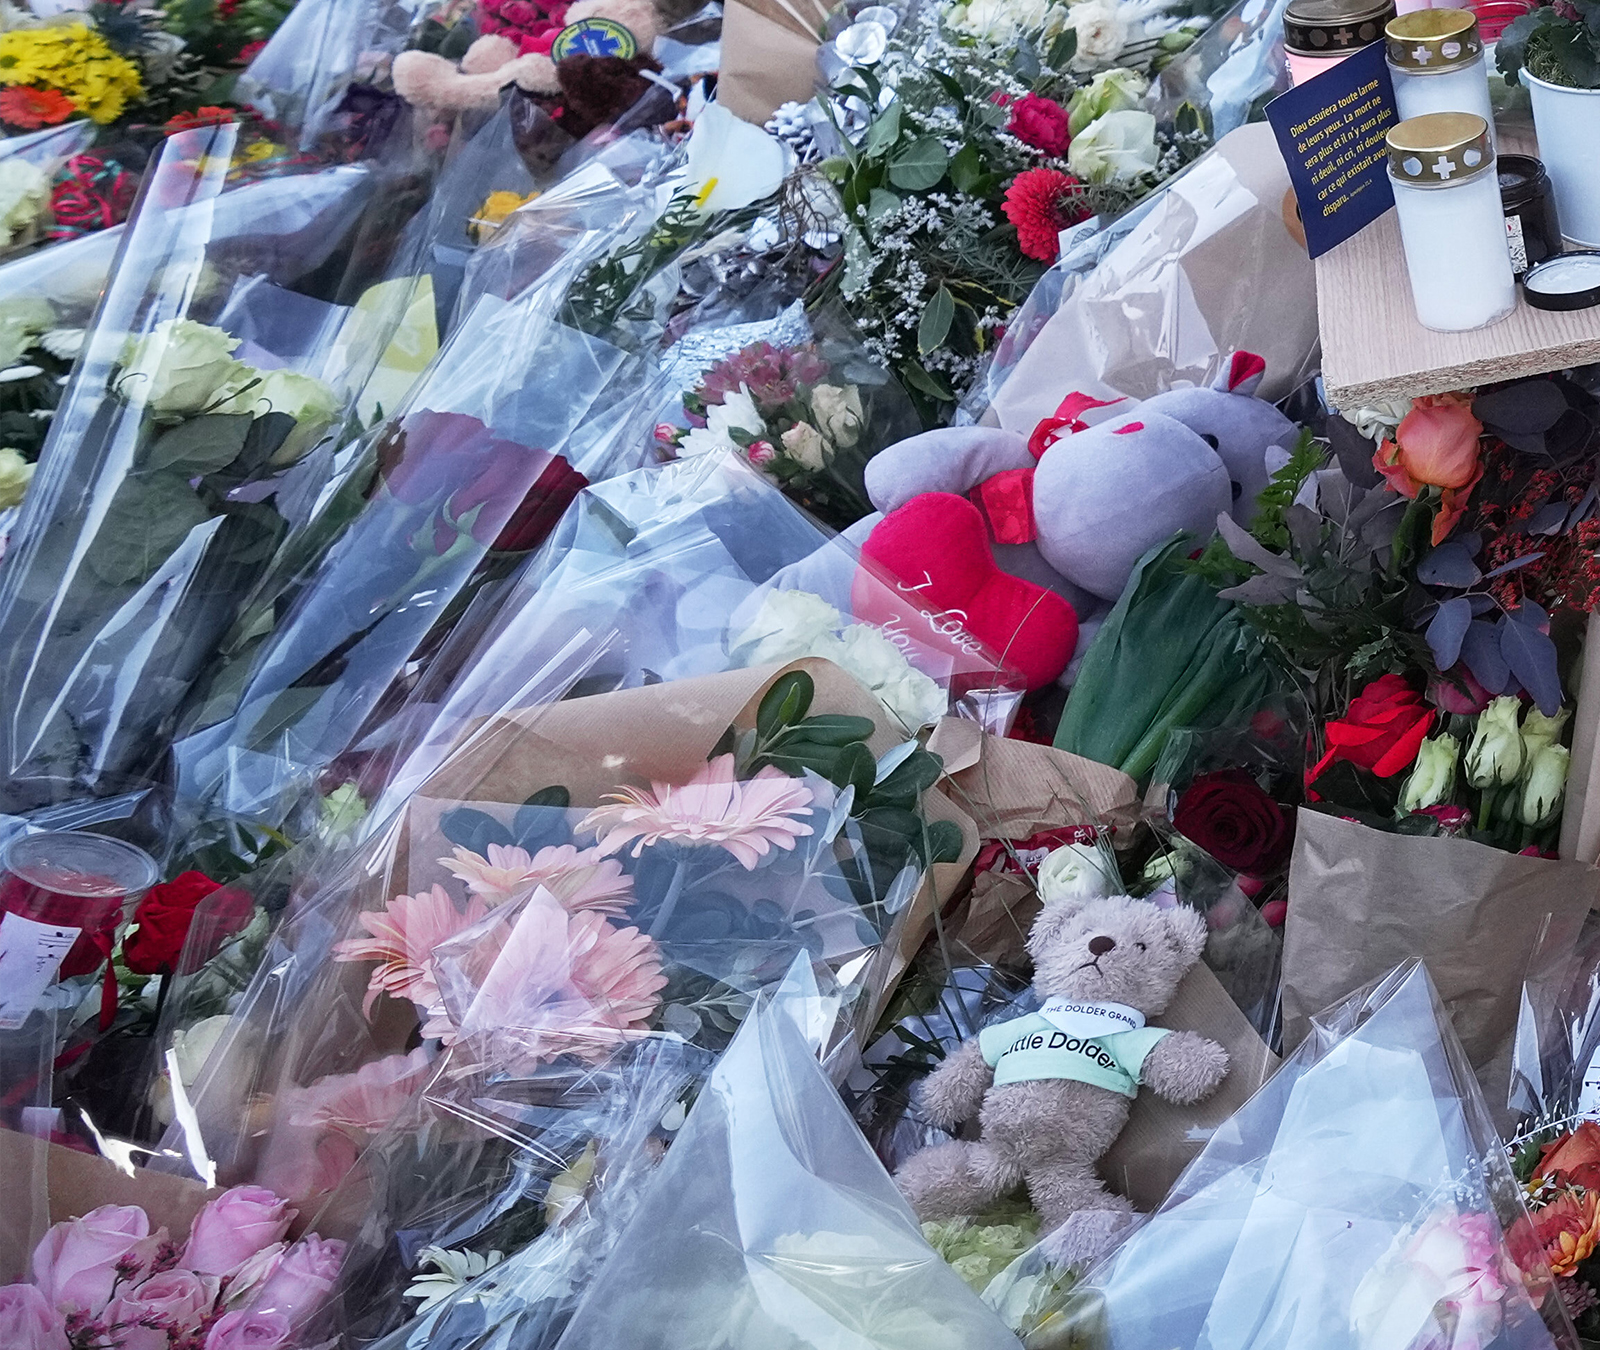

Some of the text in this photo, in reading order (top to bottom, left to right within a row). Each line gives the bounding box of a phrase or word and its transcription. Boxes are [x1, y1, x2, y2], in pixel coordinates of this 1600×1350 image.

[1290, 79, 1379, 138] Dieu essuiera toute larme
[1297, 96, 1382, 154] de leurs yeux. La mort ne
[1304, 157, 1319, 170] sera
[1318, 144, 1333, 162] plus
[1334, 137, 1344, 149] et
[1341, 130, 1349, 145] il
[1360, 118, 1377, 133] aura
[1377, 107, 1392, 125] plus
[1311, 173, 1319, 186] ni
[1317, 159, 1338, 180] deuil,
[1337, 154, 1345, 167] ni
[1344, 145, 1357, 161] cri,
[1356, 141, 1365, 154] ni
[1317, 187, 1329, 201] car
[1328, 181, 1337, 194] ce
[1336, 170, 1348, 189] qui
[1346, 155, 1373, 180] existait
[1322, 194, 1350, 218] disparu.
[920, 609, 982, 656] Love
[1045, 1004, 1138, 1030] THE DOLDER GRAND
[1047, 1031, 1117, 1070] Dolder
